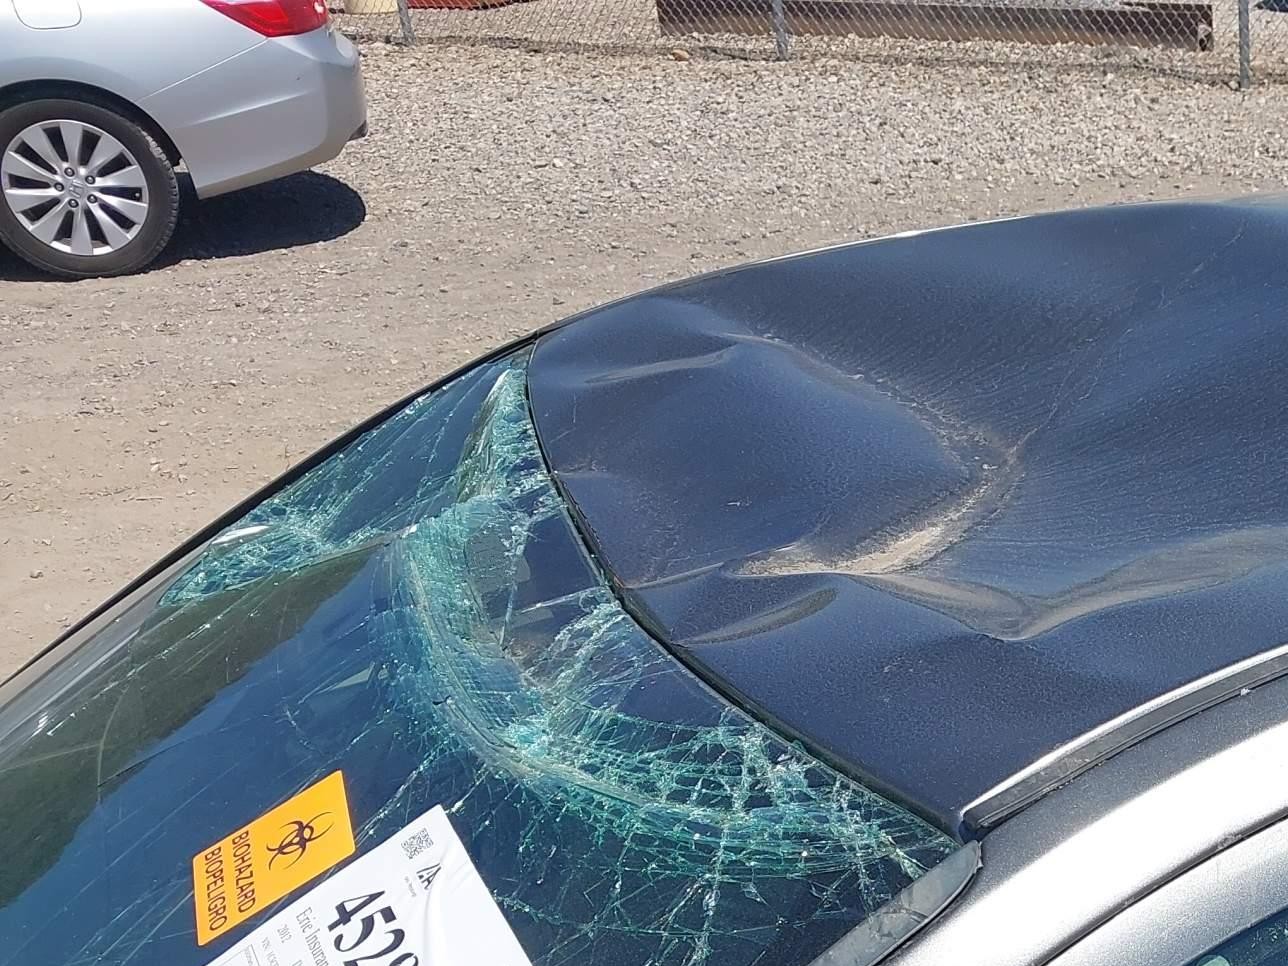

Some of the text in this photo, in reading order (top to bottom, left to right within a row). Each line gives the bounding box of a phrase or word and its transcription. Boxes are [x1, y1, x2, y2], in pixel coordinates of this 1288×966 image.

[202, 847, 227, 931] BIOPELIGRO
[229, 828, 260, 913] BIOHAZARD
[276, 923, 293, 944] 2012
[295, 906, 317, 934] Erie
